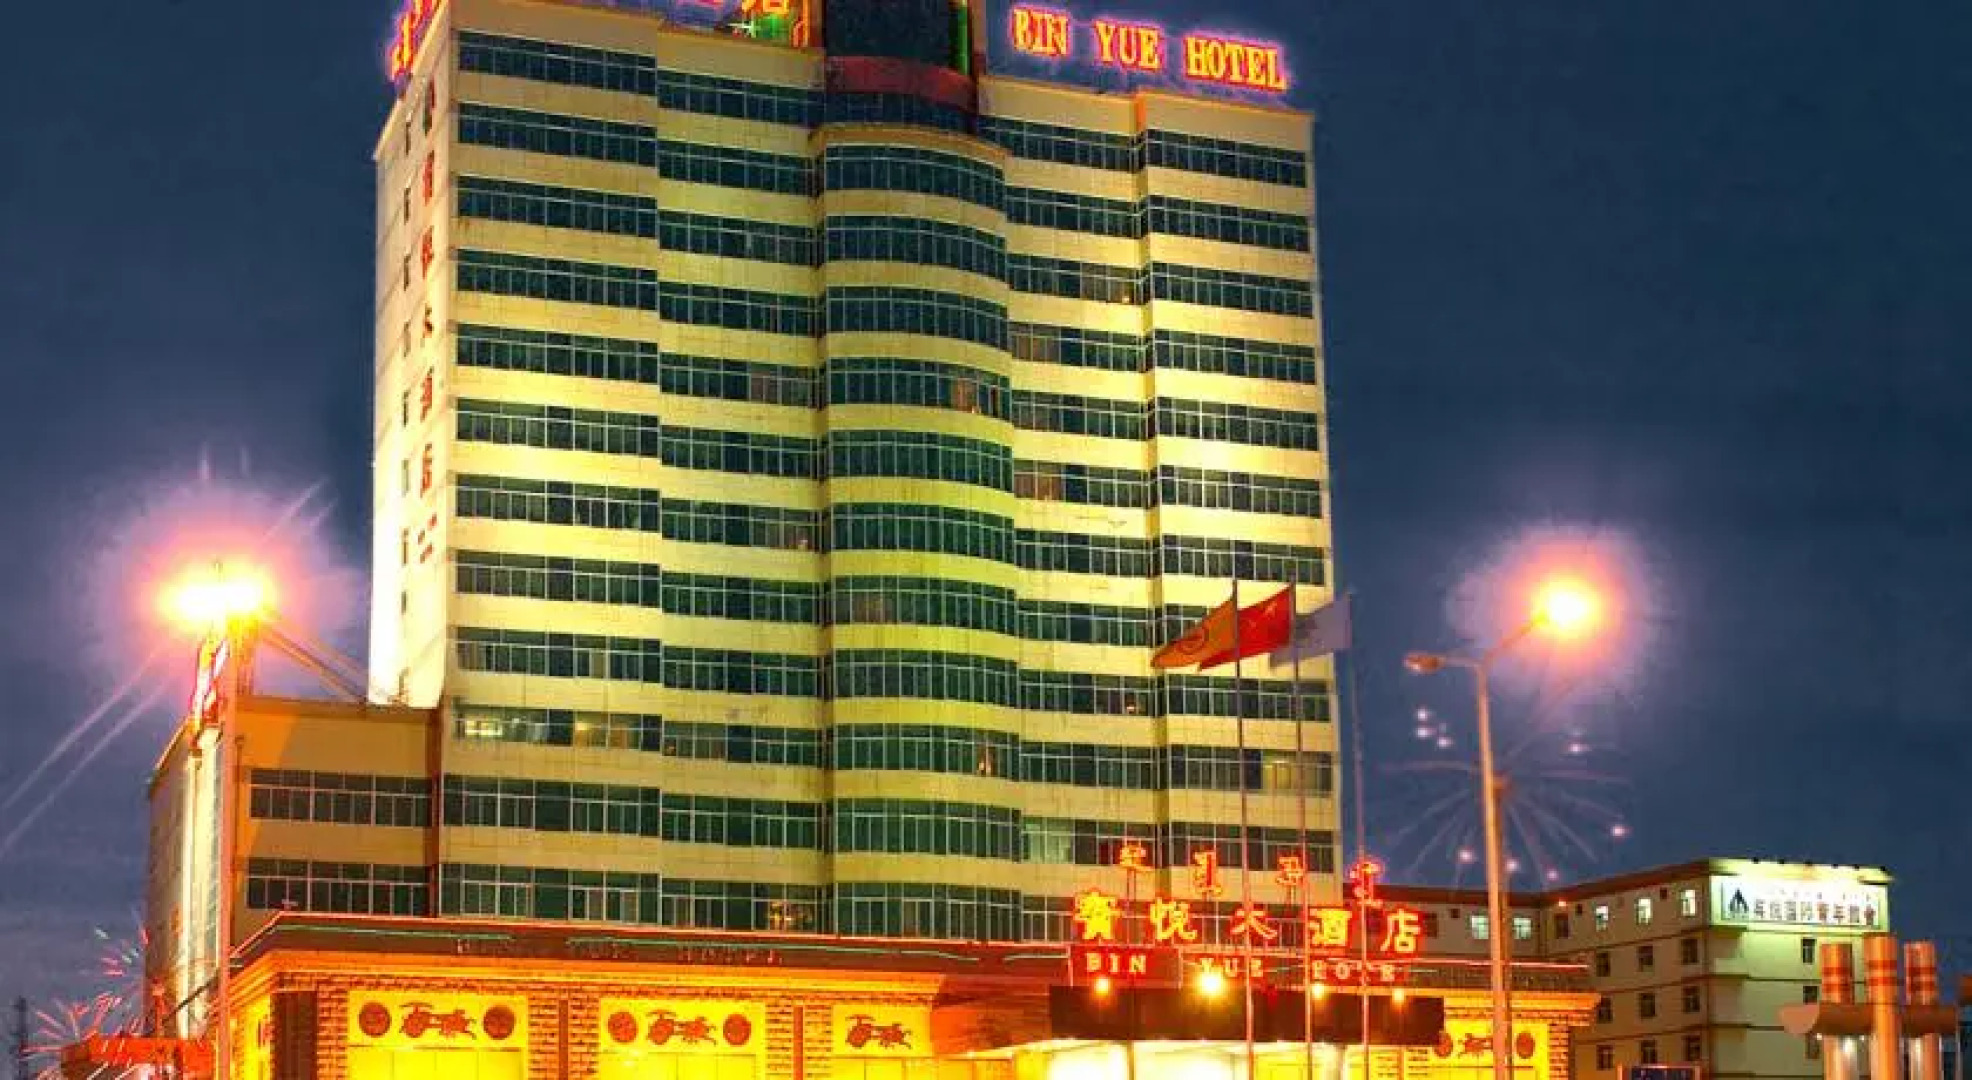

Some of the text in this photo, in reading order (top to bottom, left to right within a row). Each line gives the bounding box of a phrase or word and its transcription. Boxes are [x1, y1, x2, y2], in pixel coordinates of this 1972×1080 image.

[1012, 9, 1287, 90] BIN YUE HOTEL
[1086, 952, 1147, 974] BIN
